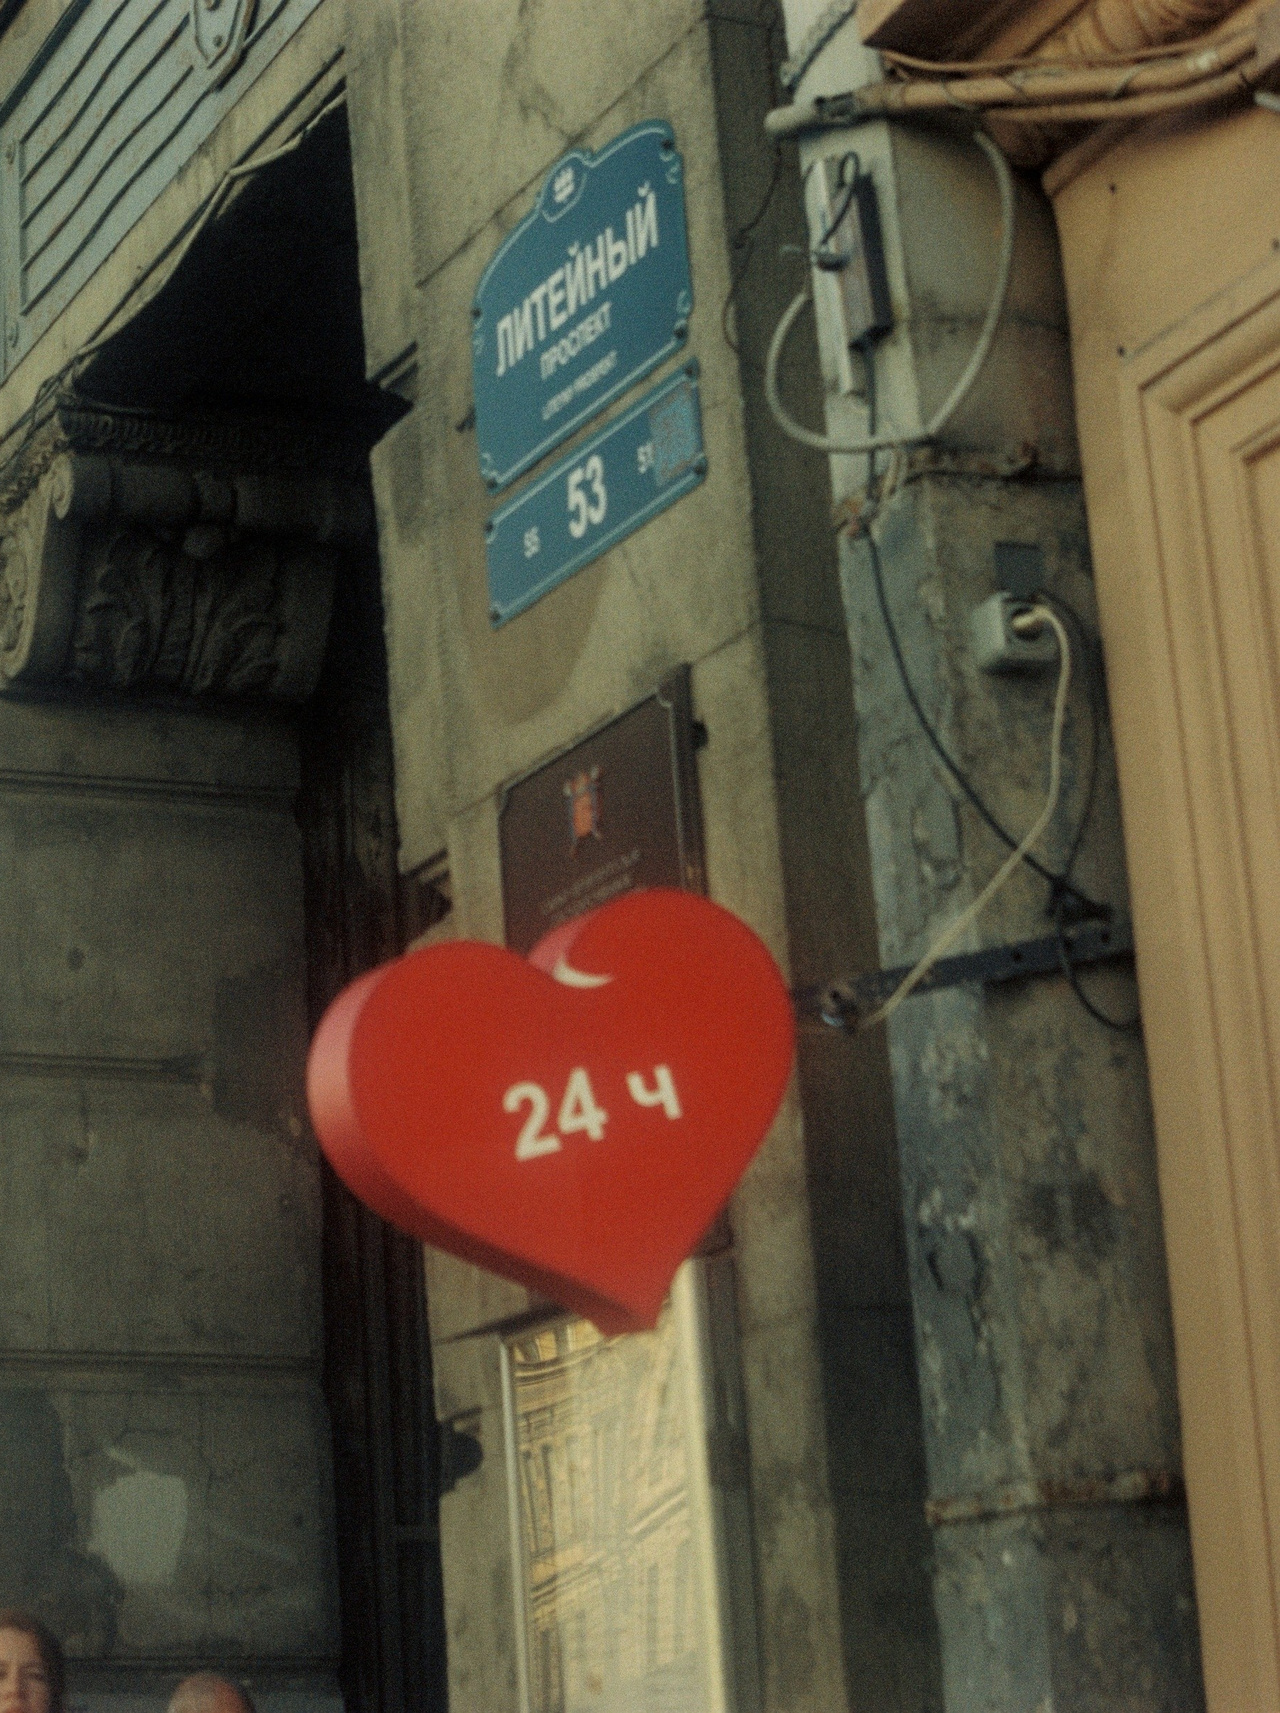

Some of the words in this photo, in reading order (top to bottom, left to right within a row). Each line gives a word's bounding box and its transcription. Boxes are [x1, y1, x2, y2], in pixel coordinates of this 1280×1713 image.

[496, 180, 659, 378] ЛИТЕЙНЫЙ
[539, 301, 612, 381] ПРОСПЕКТ
[566, 454, 608, 538] 53
[502, 1066, 609, 1162] 24
